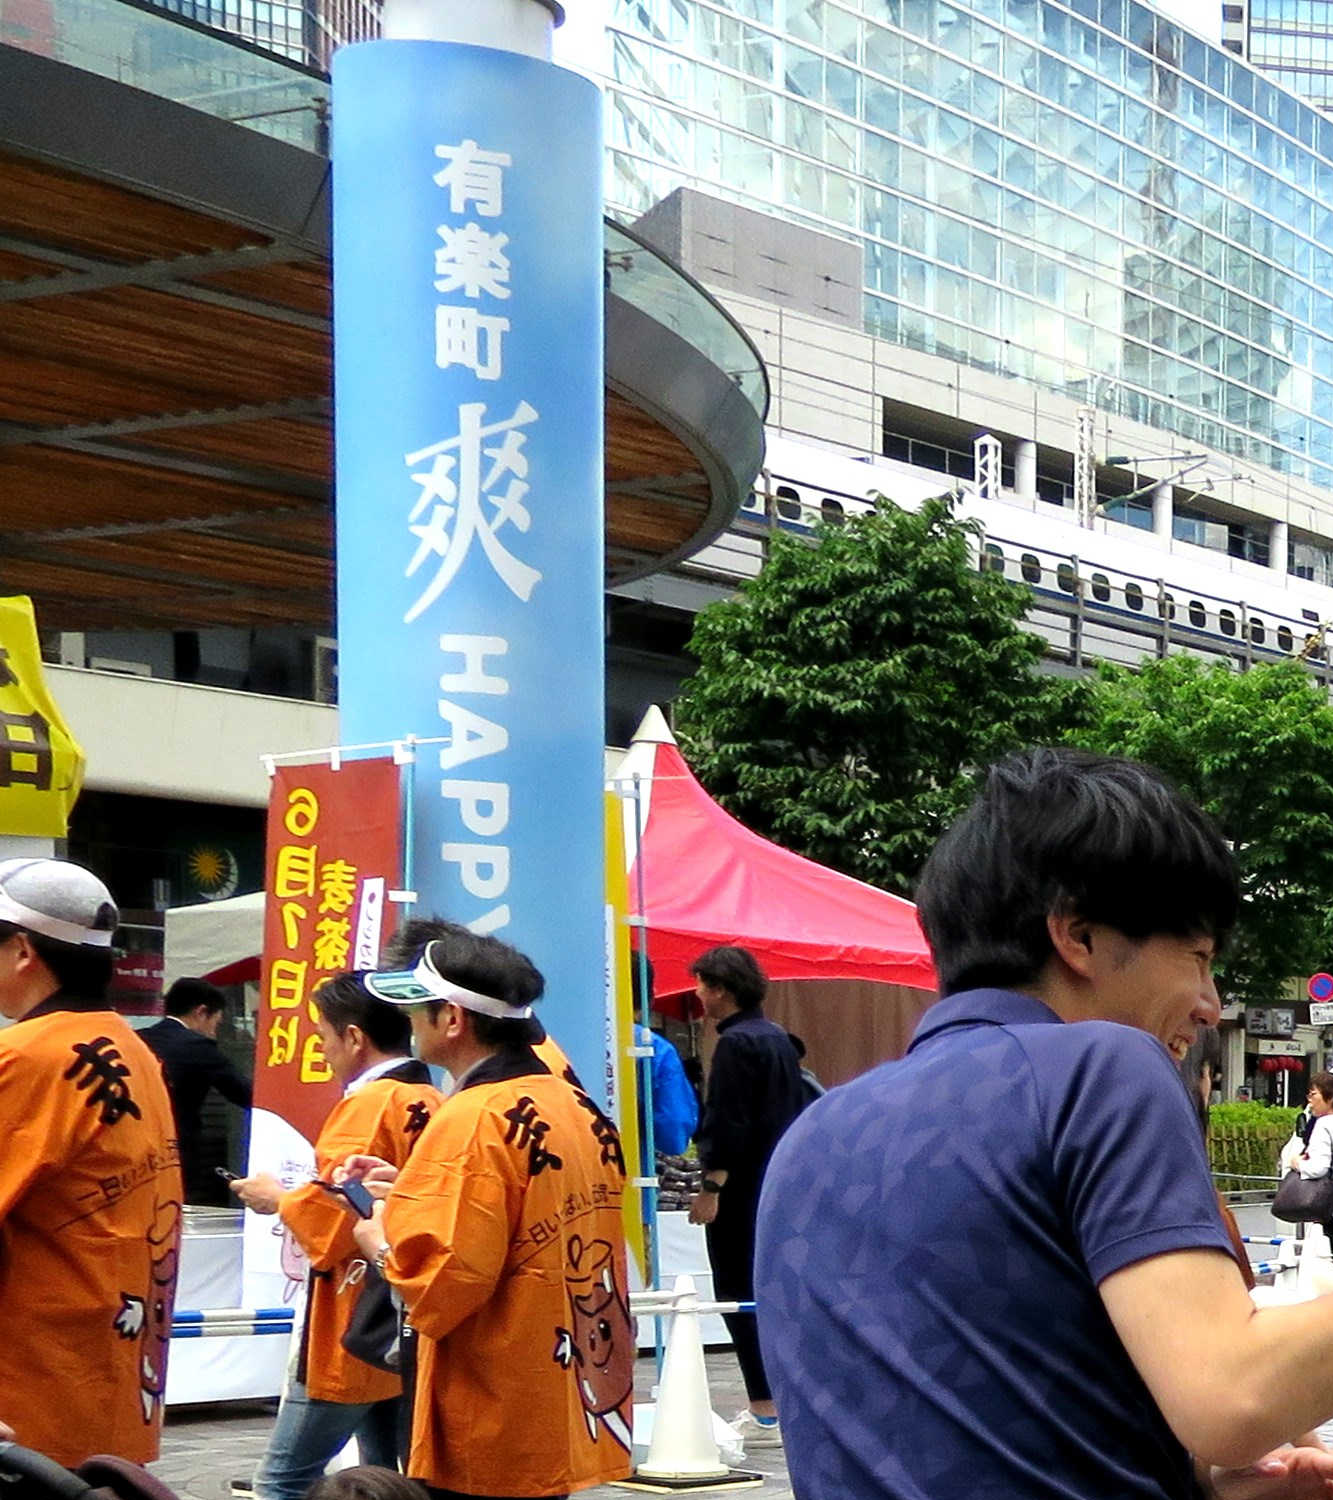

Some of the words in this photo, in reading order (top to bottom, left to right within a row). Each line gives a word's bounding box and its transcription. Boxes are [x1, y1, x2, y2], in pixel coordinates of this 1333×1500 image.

[434, 140, 512, 381] 有楽町
[404, 400, 543, 623] 爽
